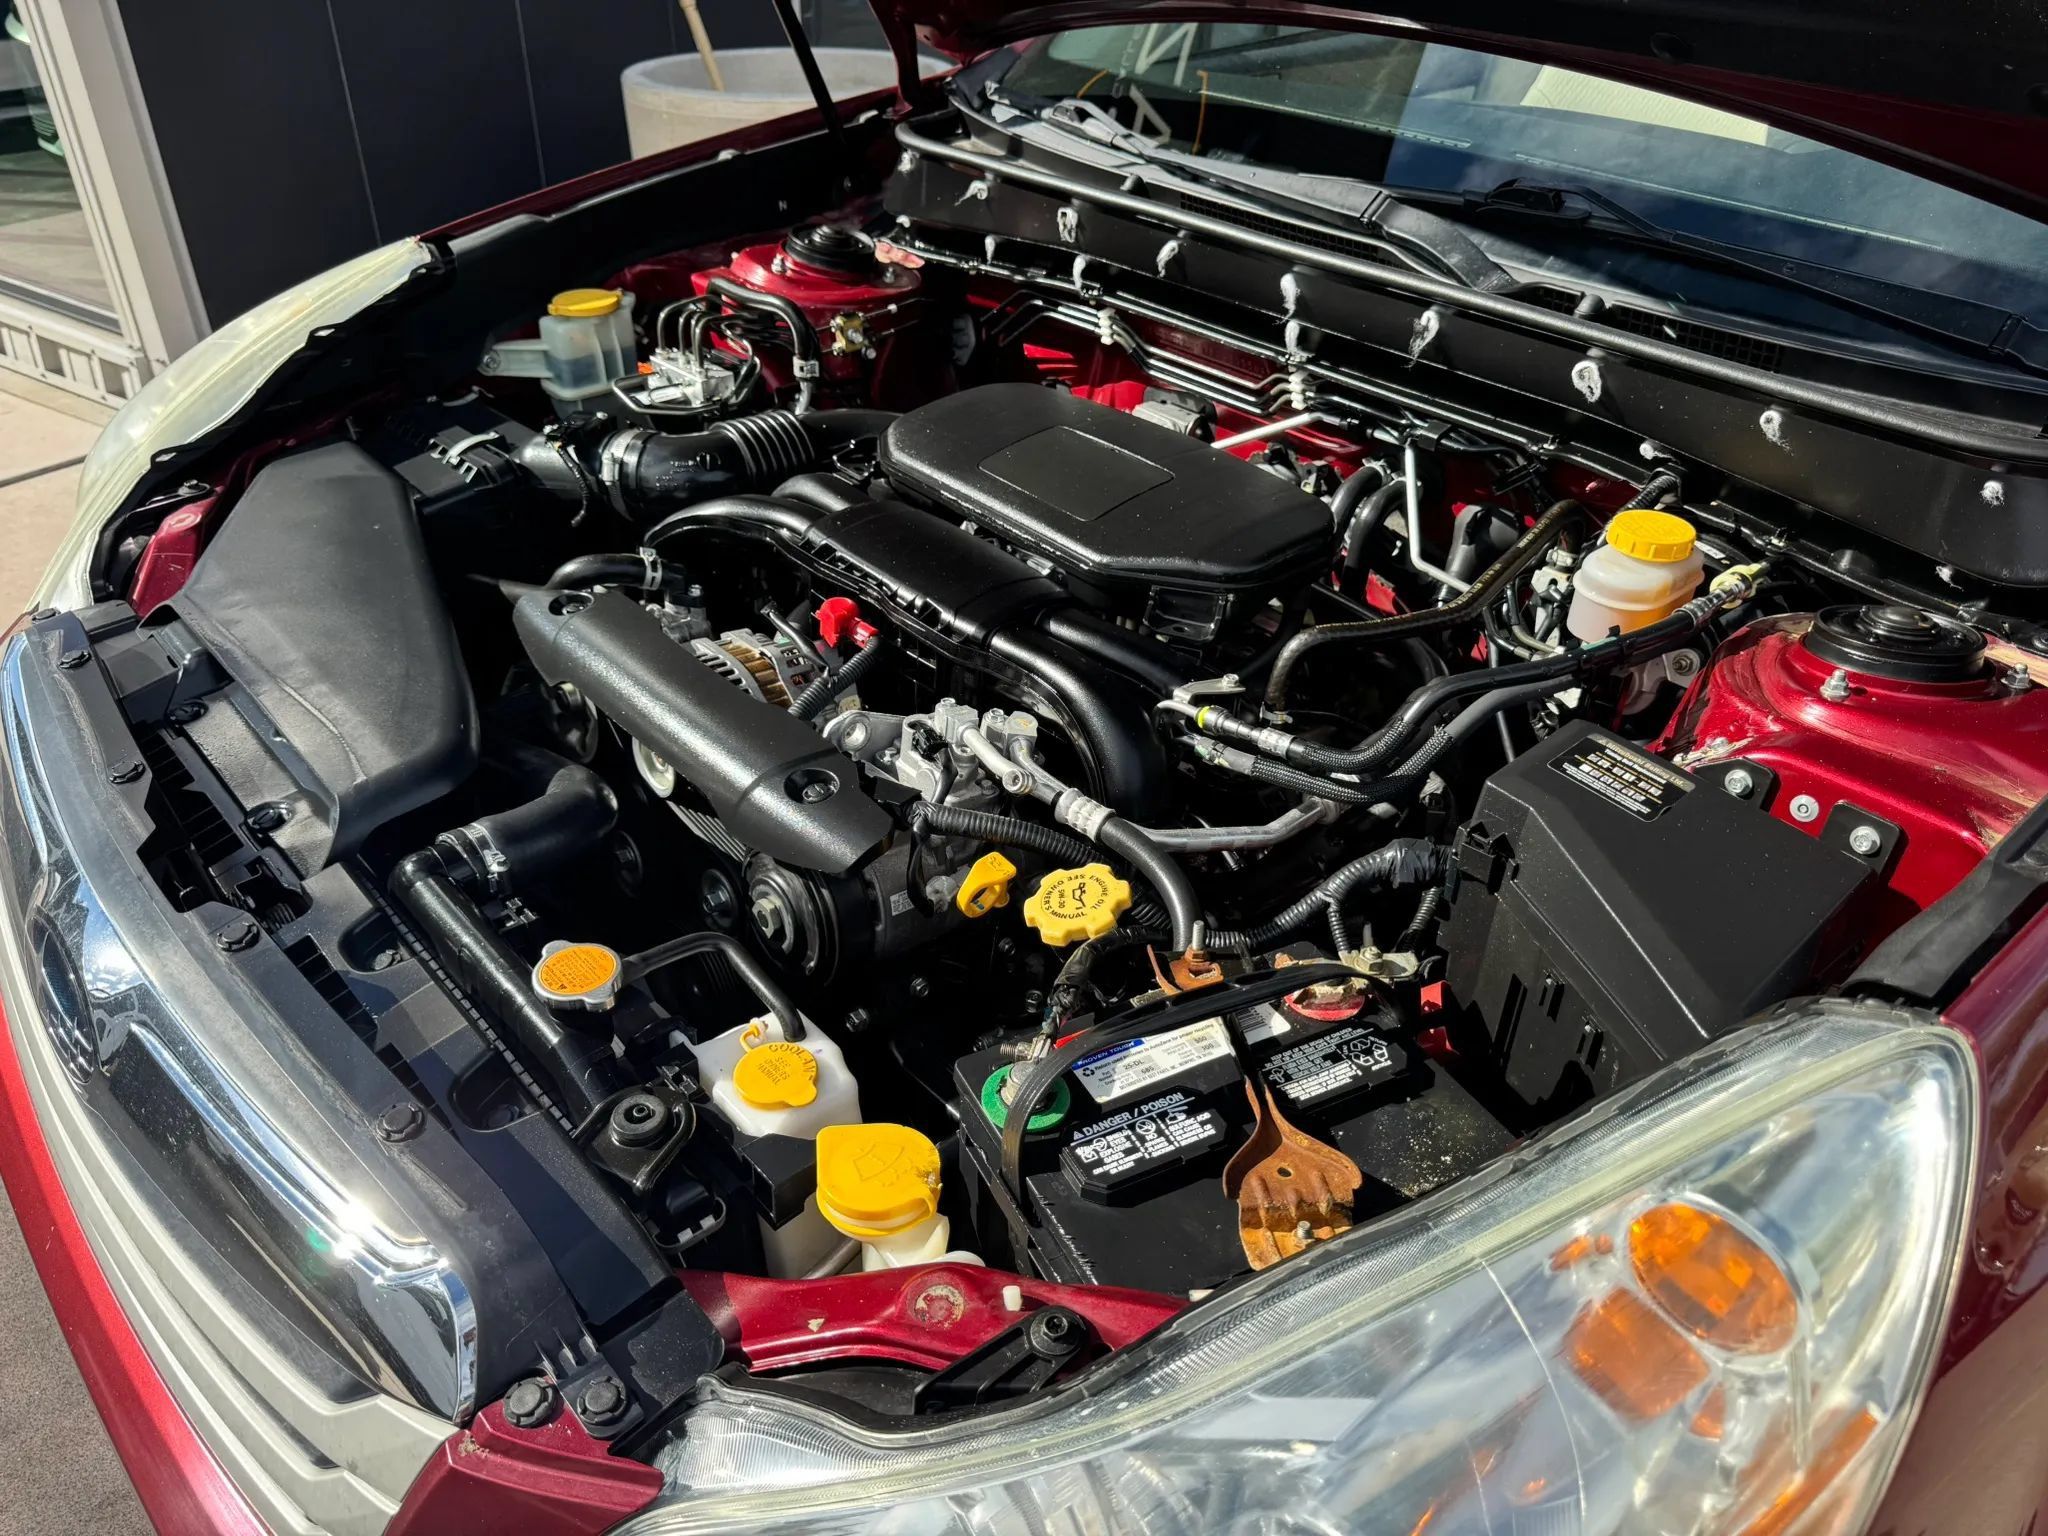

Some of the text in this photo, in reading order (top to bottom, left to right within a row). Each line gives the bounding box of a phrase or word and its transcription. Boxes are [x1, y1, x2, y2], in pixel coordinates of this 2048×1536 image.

[1644, 763, 1670, 779] Belting
[1670, 776, 1685, 786] Ltd.
[1057, 889, 1065, 909] 5W-30
[1089, 875, 1108, 910] ENGINE OIL
[1050, 910, 1087, 919] MANUAL
[1078, 1041, 1134, 1066] PROVEN TOUGH
[1082, 1112, 1132, 1136] DANGER
[1141, 1092, 1184, 1114] POISON
[1106, 1130, 1128, 1141] SHIELD
[1110, 1137, 1127, 1146] EYES
[1145, 1133, 1158, 1141] NO
[1099, 1141, 1132, 1157] EXPLOSIVE
